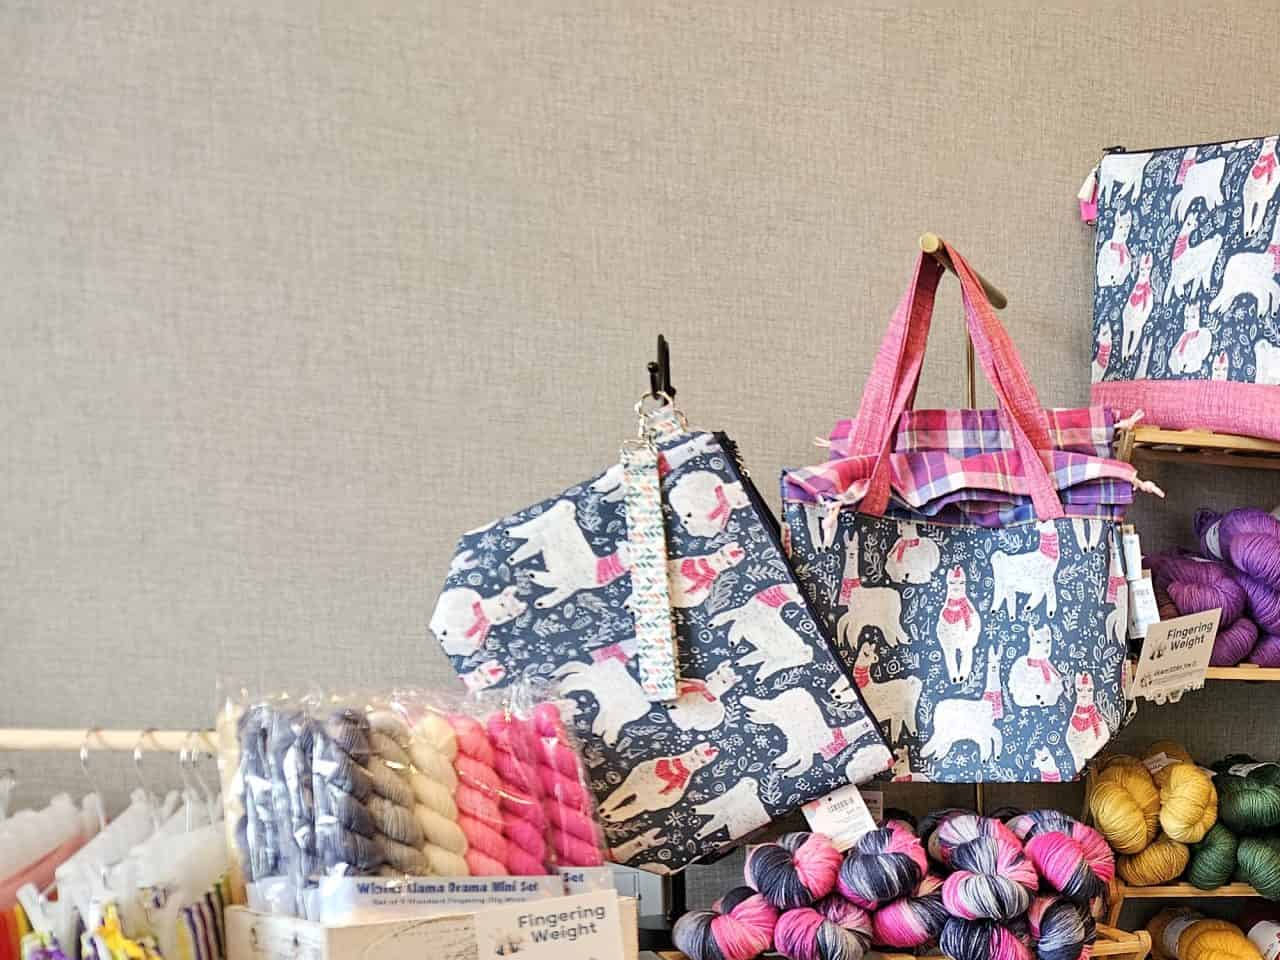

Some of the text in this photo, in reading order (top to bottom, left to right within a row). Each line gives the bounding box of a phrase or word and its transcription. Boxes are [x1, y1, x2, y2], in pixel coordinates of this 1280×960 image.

[1166, 621, 1214, 640] Fingering
[1170, 635, 1205, 651] Weight
[448, 881, 488, 893] Drama
[491, 881, 516, 892] Mini
[520, 881, 538, 892] Set
[517, 906, 606, 928] Fingering
[531, 922, 598, 943] Weight
